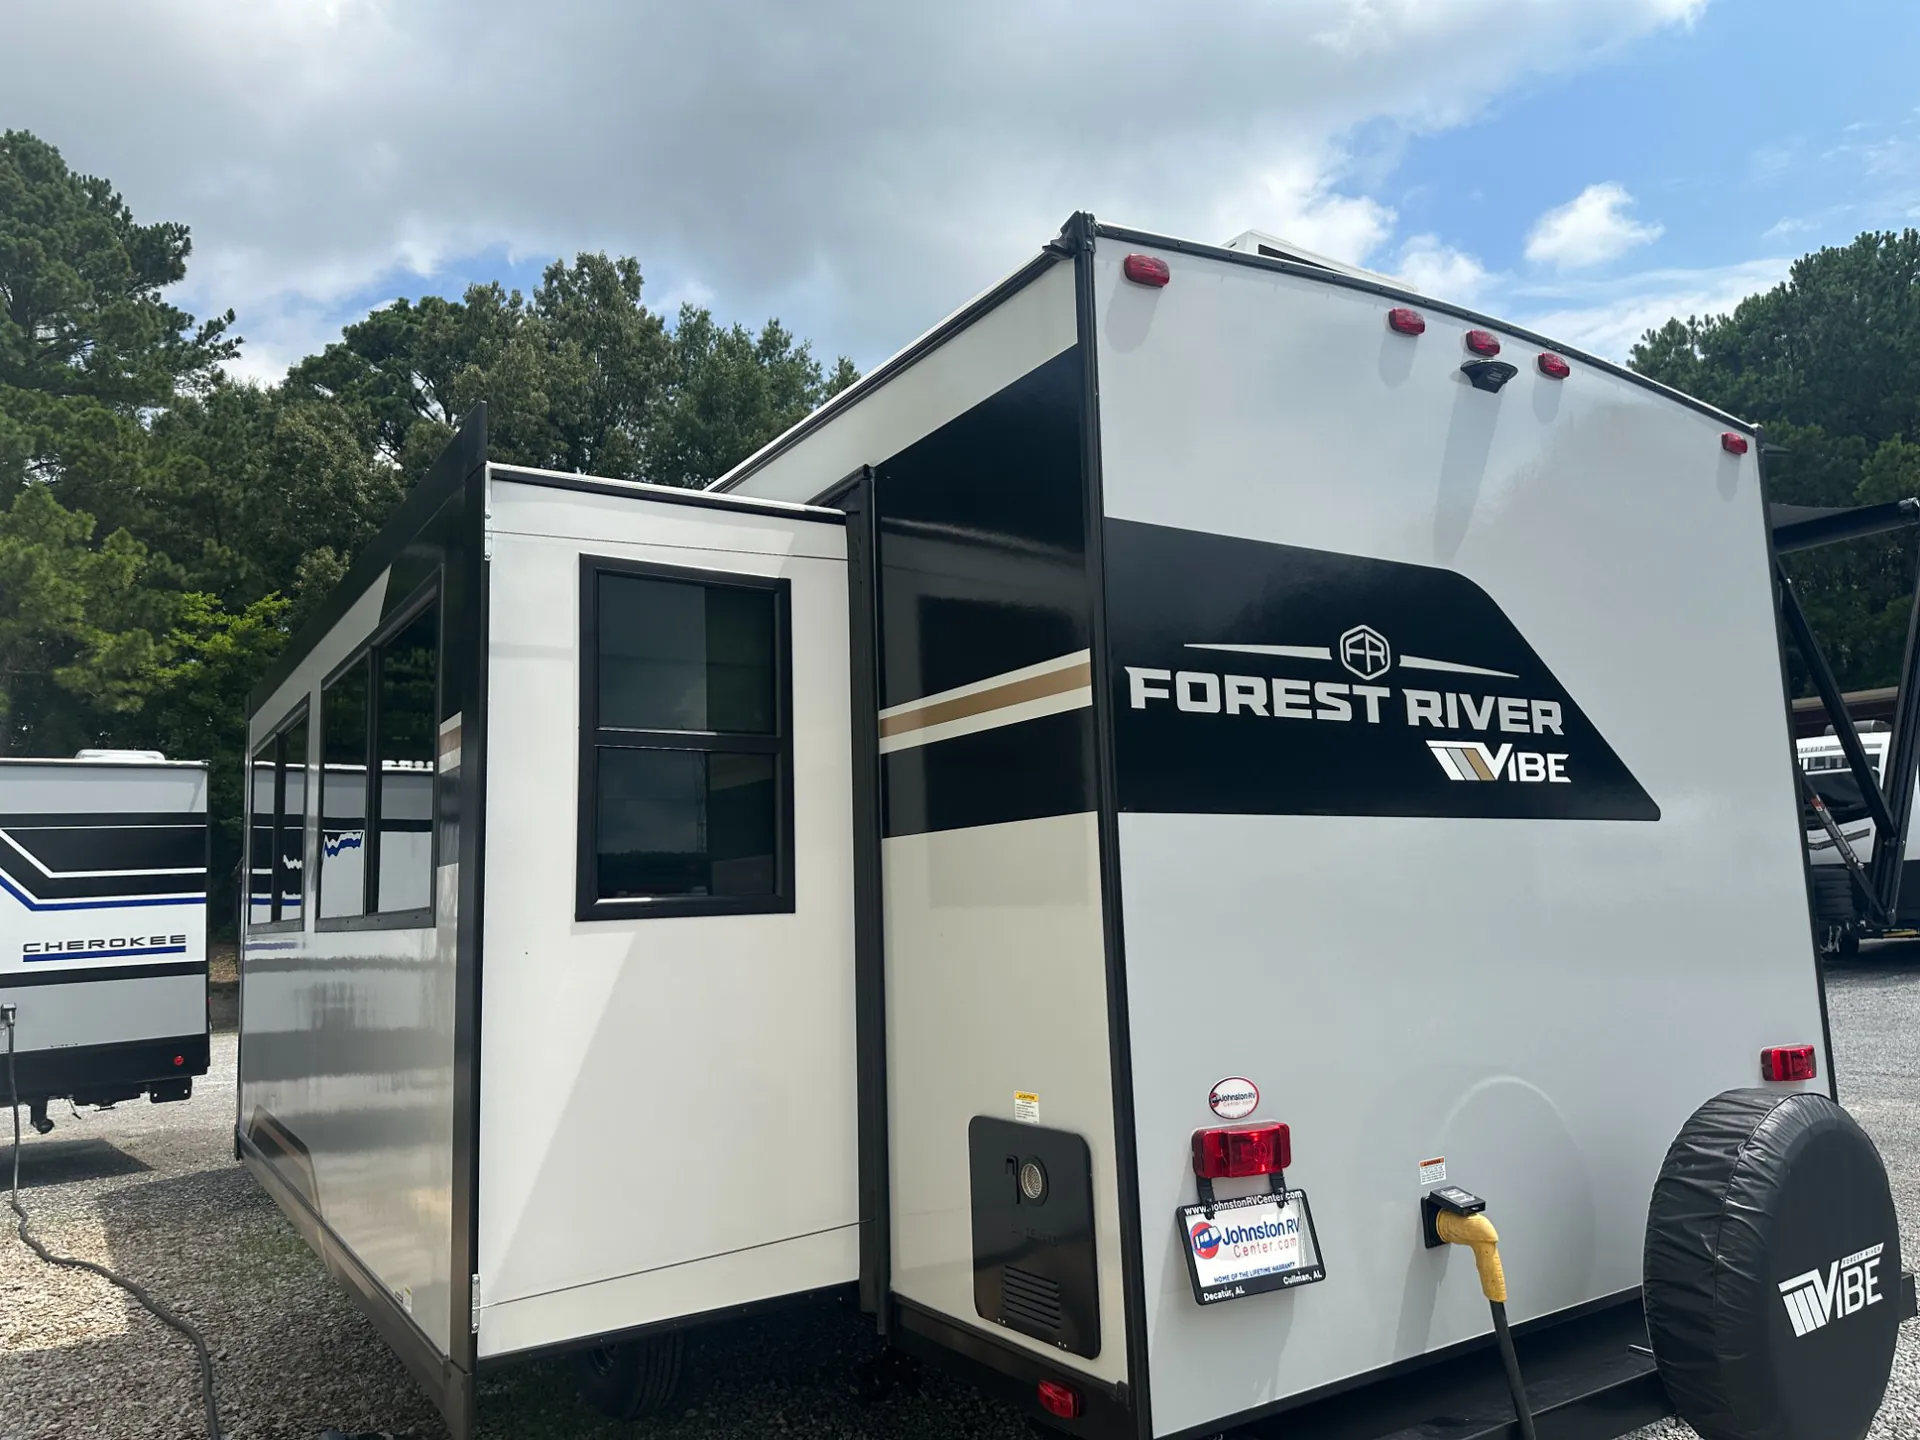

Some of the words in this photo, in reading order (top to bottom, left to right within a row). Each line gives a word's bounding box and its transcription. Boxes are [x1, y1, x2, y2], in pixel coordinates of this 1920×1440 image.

[1124, 666, 1391, 723] FOREST
[1402, 688, 1565, 735] RIVER
[1427, 740, 1572, 783] VIBE
[22, 934, 186, 953] CHEROKEE
[1184, 1190, 1303, 1216] www.JohnstonRVCentercom
[1222, 1221, 1285, 1246] Johnston
[1286, 1217, 1300, 1235] RV
[1233, 1237, 1297, 1258] Center.com
[1213, 1275, 1230, 1283] HOME
[1239, 1270, 1249, 1278] THE
[1283, 1271, 1313, 1285] Cullman,
[1313, 1270, 1323, 1279] AL
[1203, 1288, 1235, 1302] Decatur,
[1235, 1285, 1245, 1294] AL
[1780, 1257, 1884, 1335] VIBE
